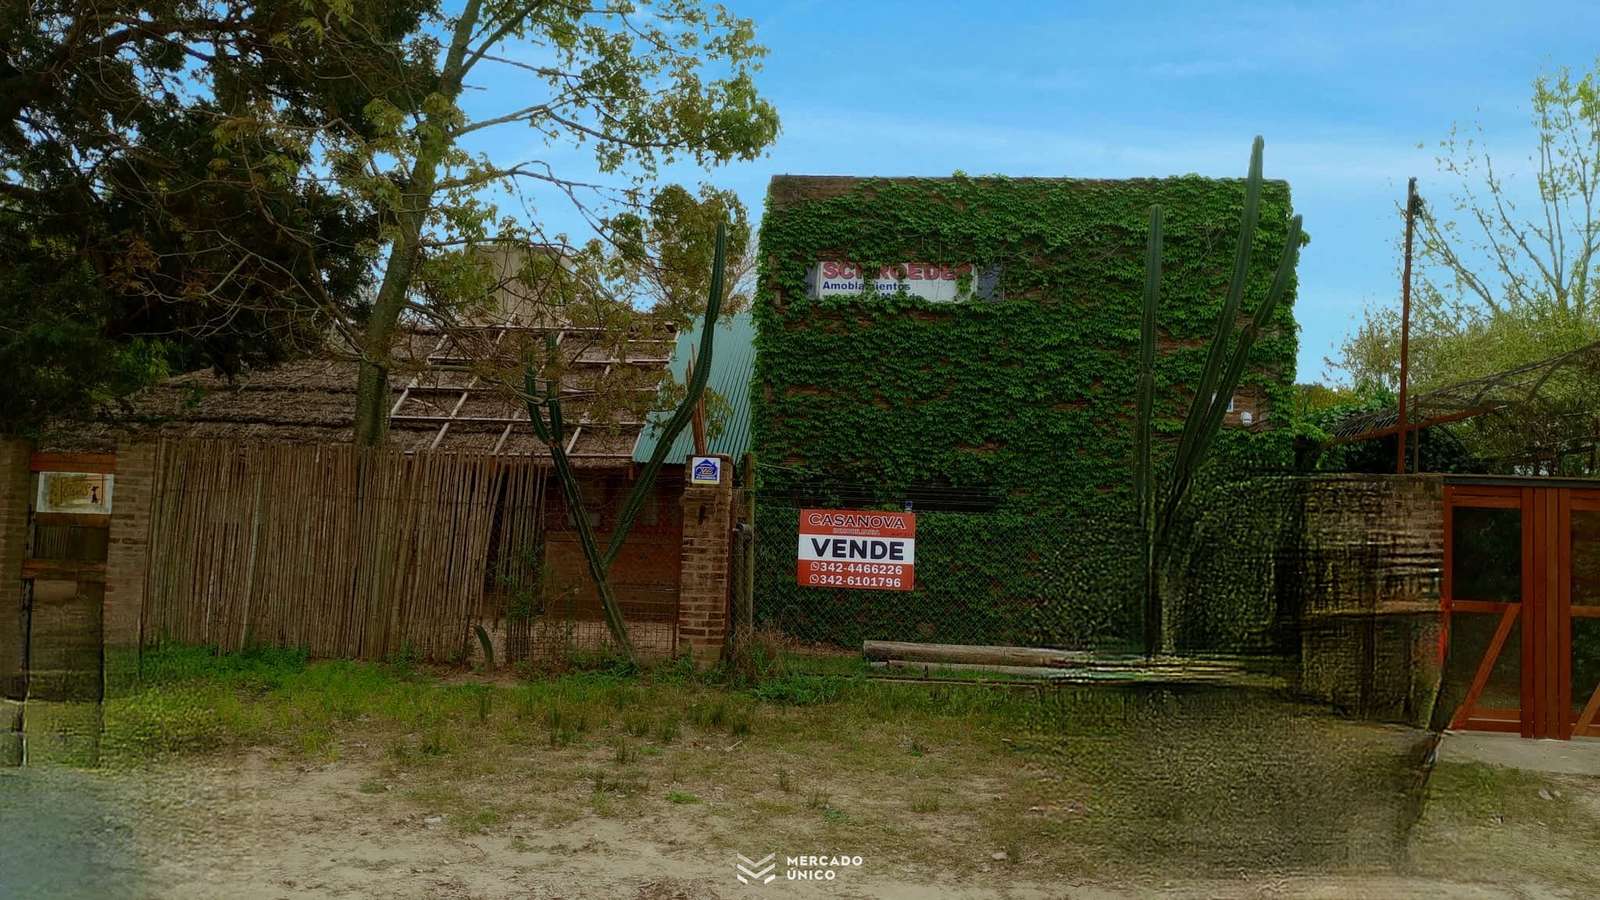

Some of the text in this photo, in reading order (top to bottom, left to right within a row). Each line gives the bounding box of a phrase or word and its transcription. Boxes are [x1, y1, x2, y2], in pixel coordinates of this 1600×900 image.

[822, 281, 911, 291] Amoblaientos
[809, 513, 906, 529] CASANOVA
[811, 538, 904, 560] VENDE
[820, 562, 903, 575] 342-4466226
[820, 575, 901, 587] 342-6101796
